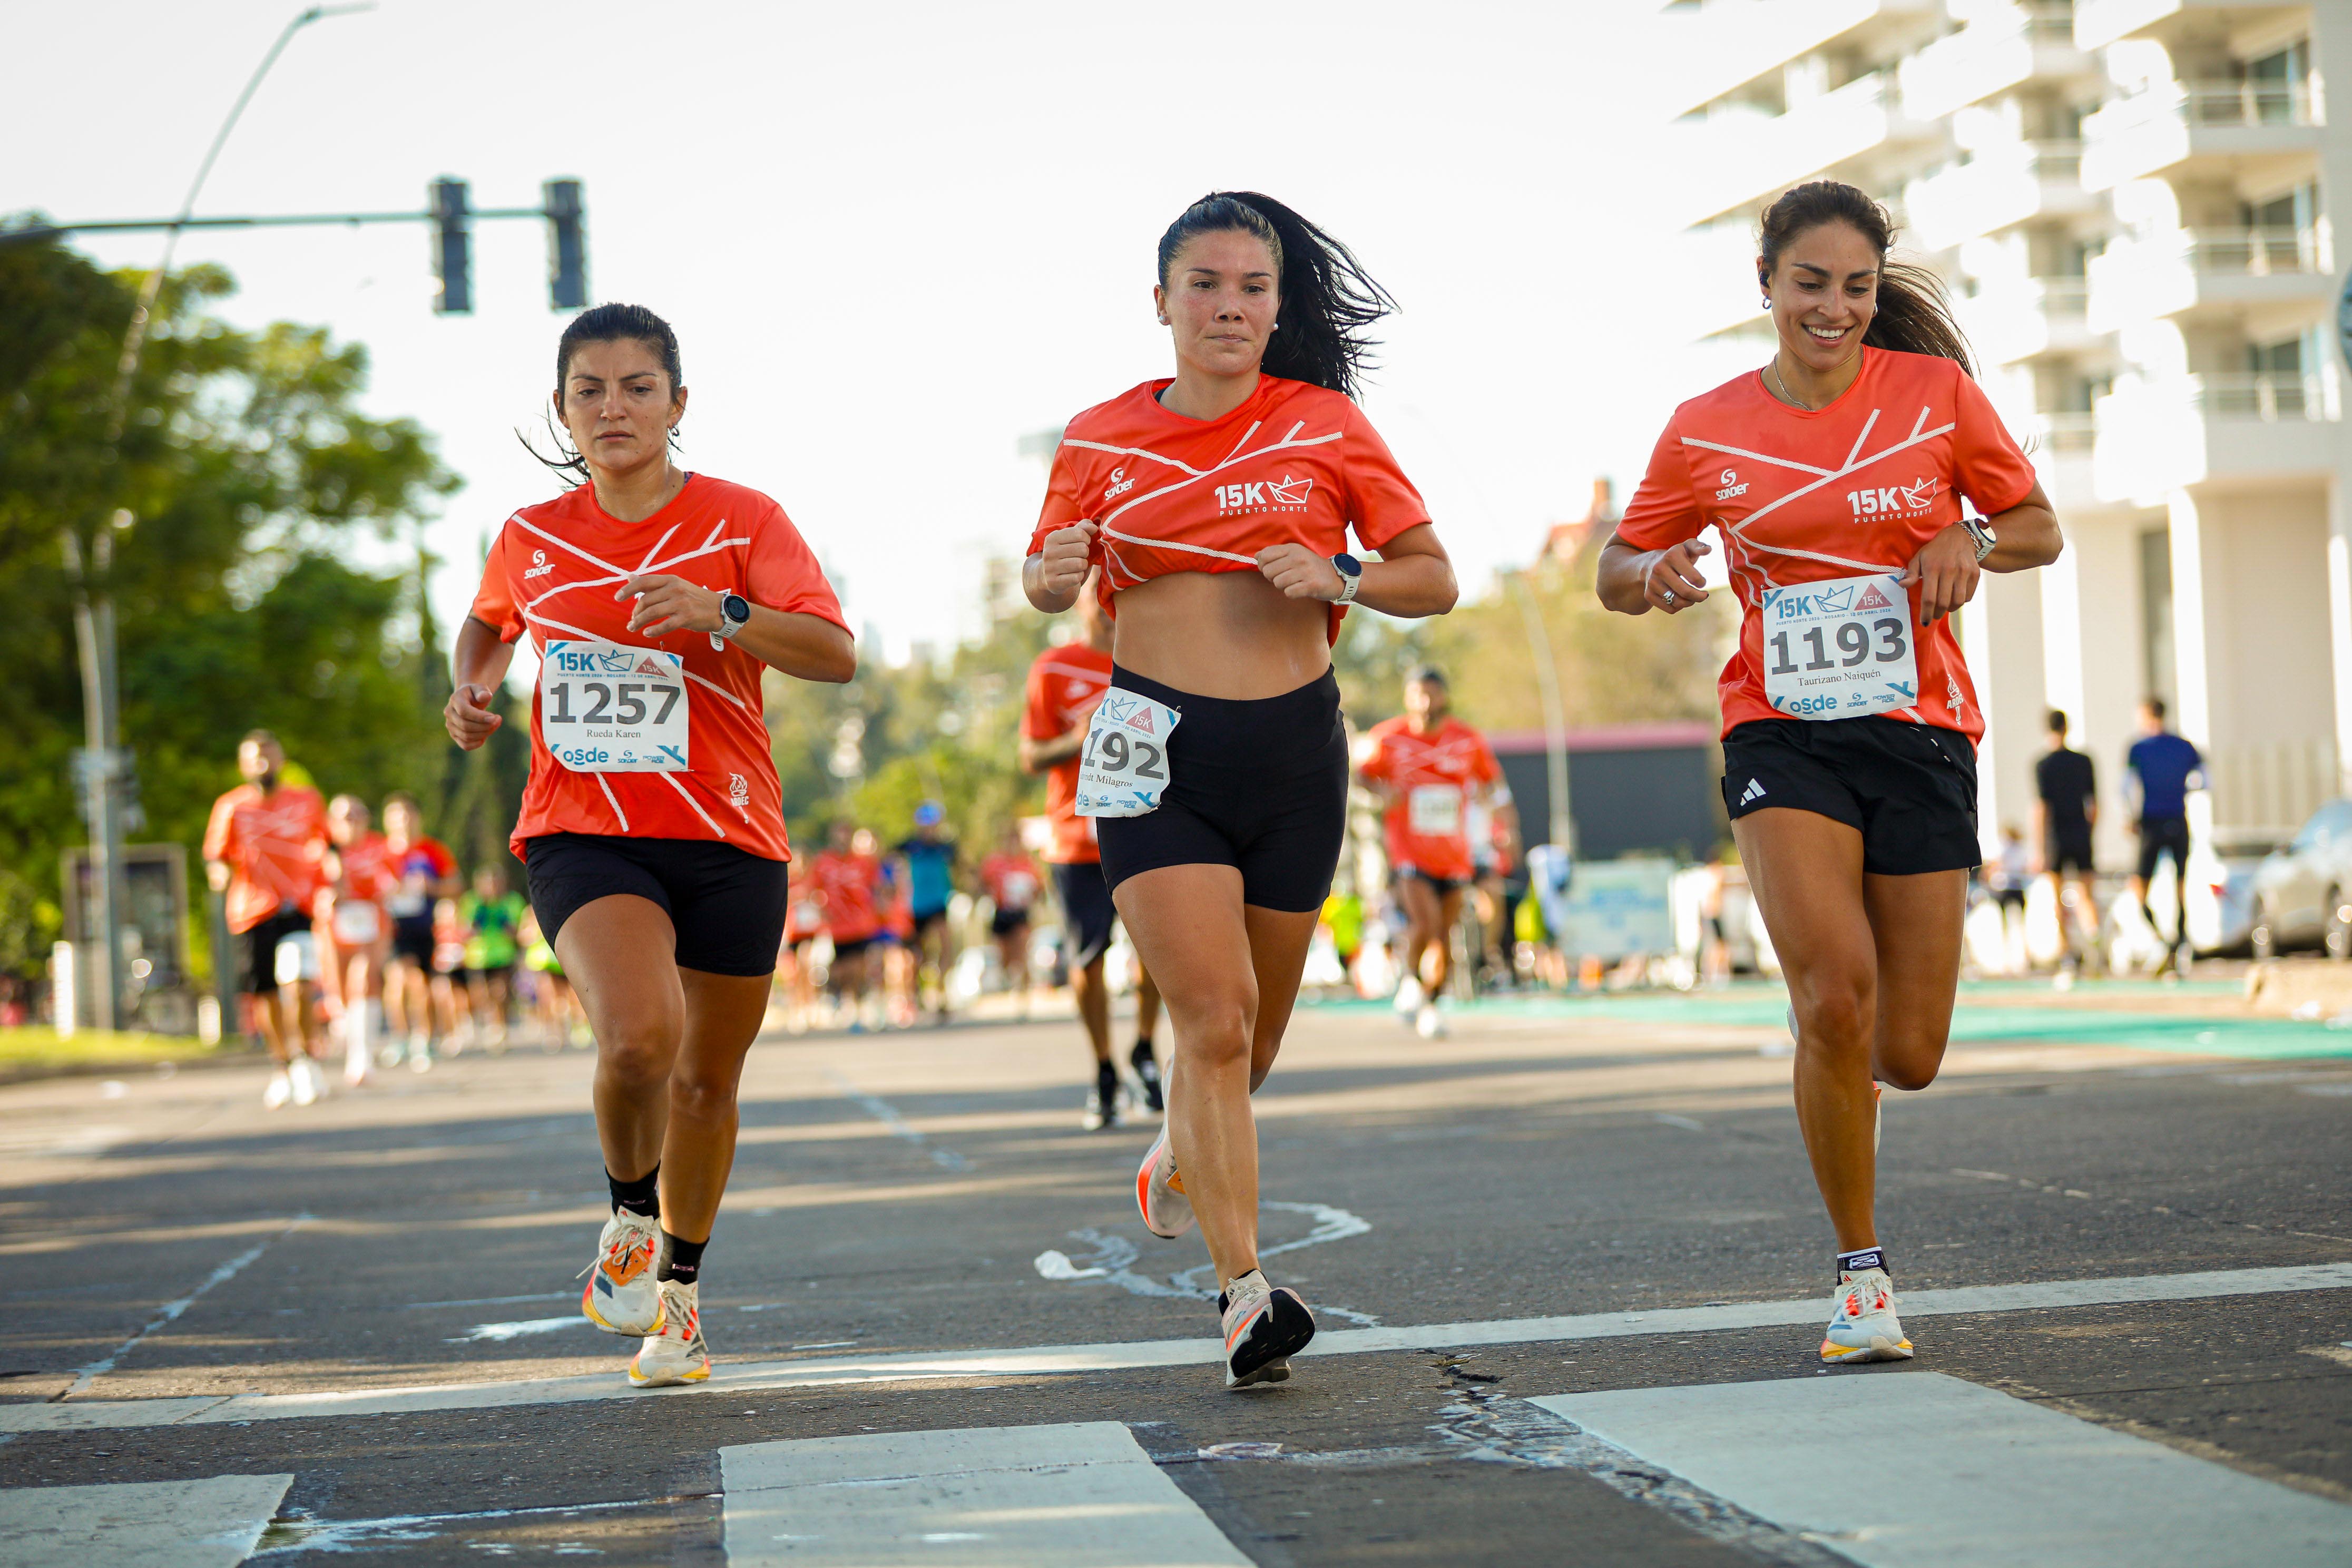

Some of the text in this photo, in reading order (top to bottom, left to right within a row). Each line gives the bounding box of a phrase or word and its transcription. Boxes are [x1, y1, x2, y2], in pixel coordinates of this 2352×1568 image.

[1214, 482, 1267, 508] 15K
[1847, 487, 1901, 515] 15K
[1220, 506, 1267, 516] PUERTO
[1854, 507, 1932, 524] PUERTO NORTE
[1776, 595, 1812, 619] 15K
[1862, 594, 1884, 606] 15K
[1770, 618, 1906, 675] 1193
[557, 653, 595, 671] 15K
[642, 664, 661, 674] 15K
[1797, 669, 1881, 686] Taurizano Naiquén
[550, 682, 680, 724] 1257
[1790, 694, 1838, 714] osde
[1134, 714, 1152, 729] 15K
[587, 729, 641, 738] Rueda Karen
[563, 747, 609, 766] osde
[1081, 727, 1164, 780] 192
[1095, 775, 1133, 788] Milagros
